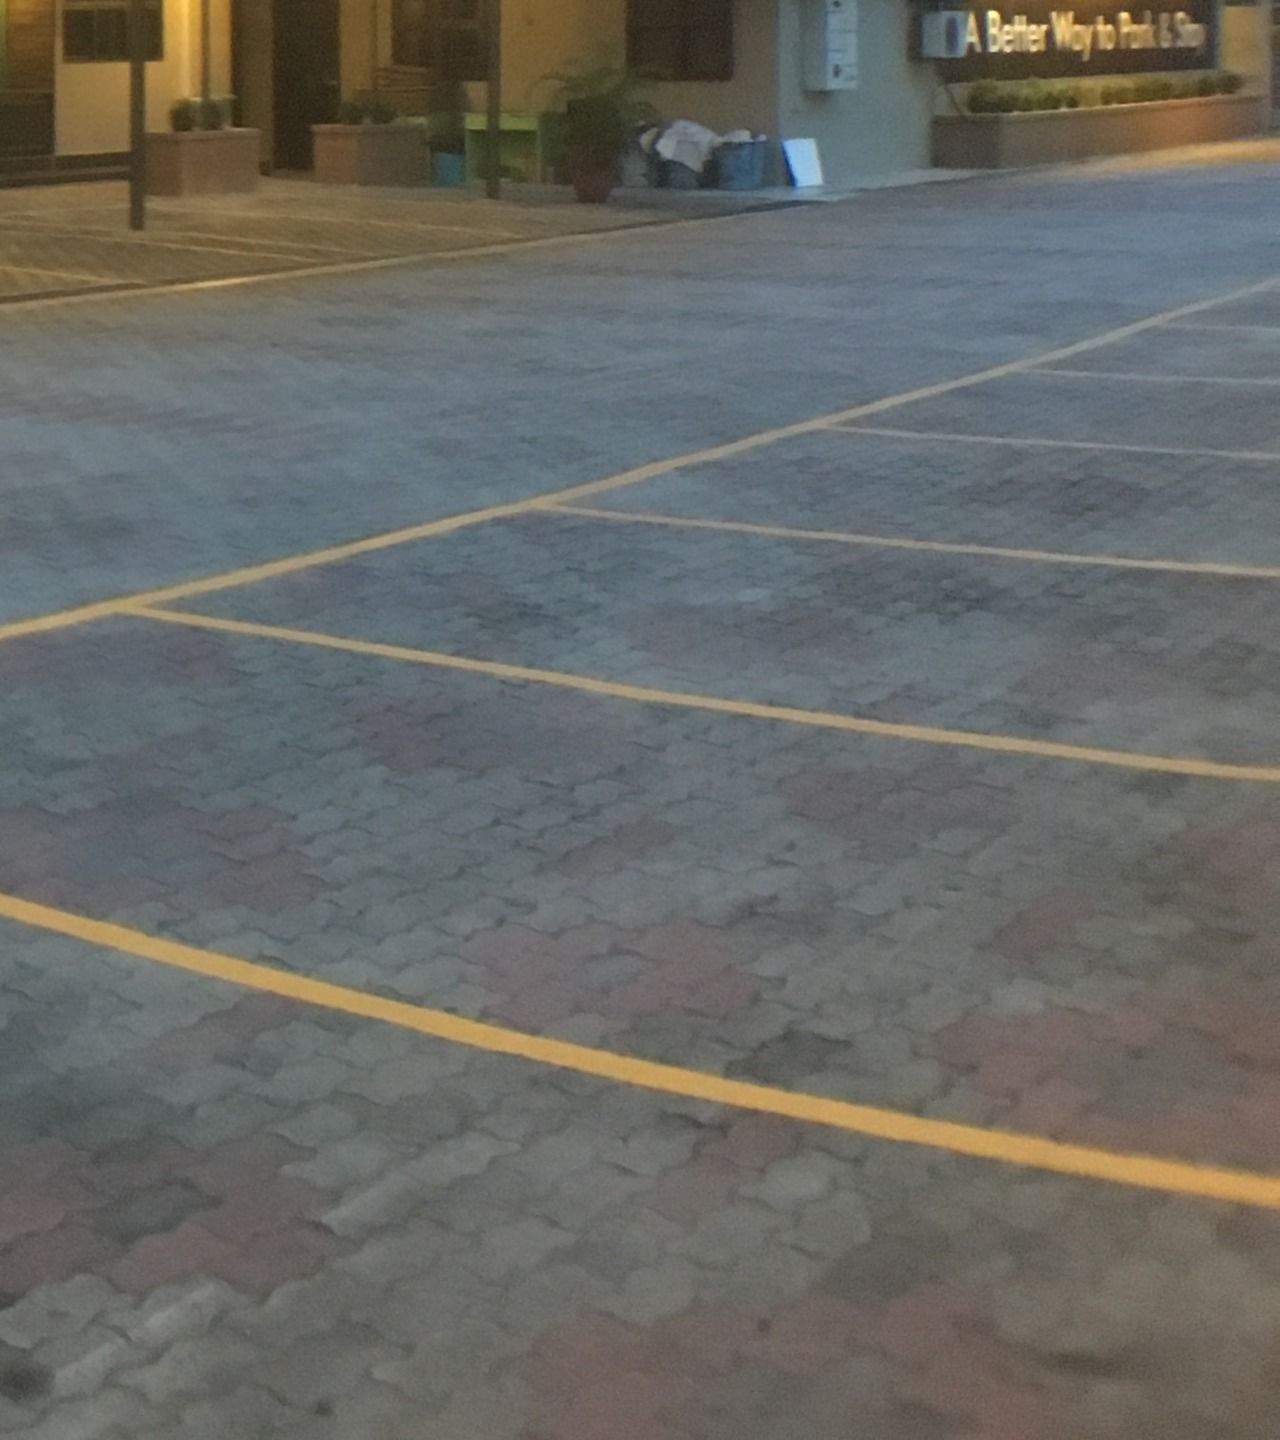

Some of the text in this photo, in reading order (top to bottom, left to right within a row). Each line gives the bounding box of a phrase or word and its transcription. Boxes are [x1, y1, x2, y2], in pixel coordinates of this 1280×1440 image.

[966, 12, 981, 52] A
[986, 10, 1048, 53] Better
[1050, 10, 1094, 62] Way
[1096, 15, 1116, 51] to
